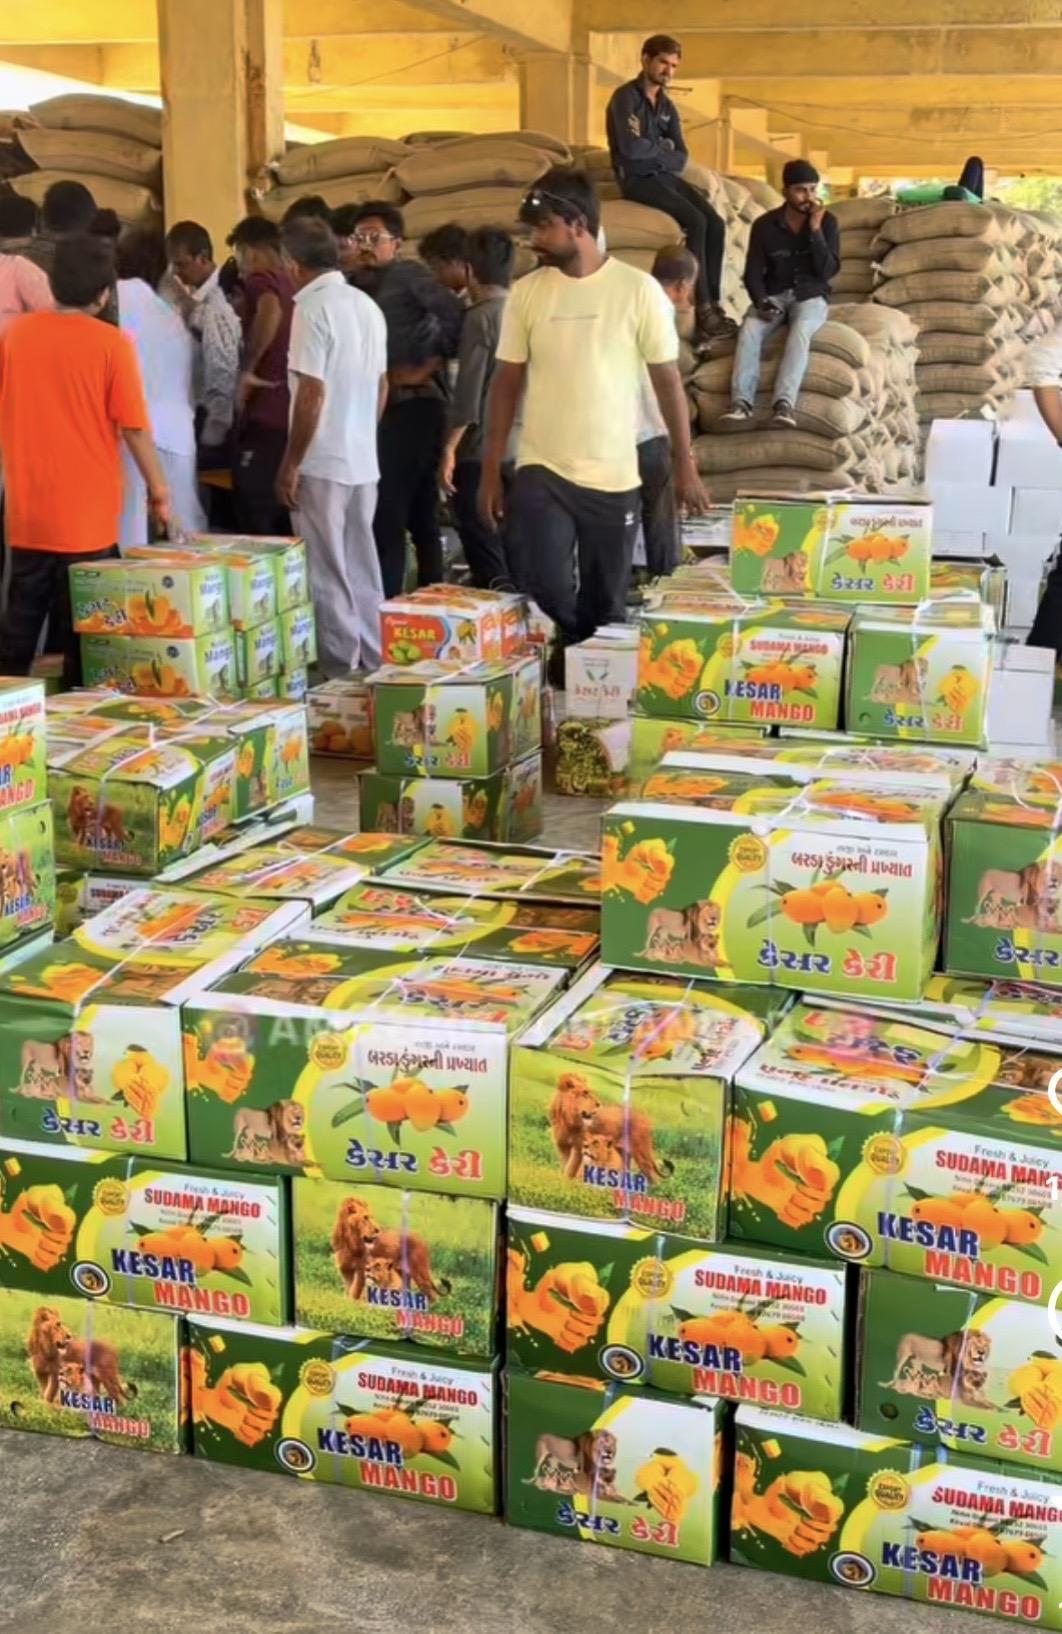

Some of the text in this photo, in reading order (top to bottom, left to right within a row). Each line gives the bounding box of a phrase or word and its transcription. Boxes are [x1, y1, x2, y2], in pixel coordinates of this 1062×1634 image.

[393, 626, 436, 641] KESAR
[724, 679, 781, 700] KESAR
[750, 700, 815, 721] MANGO
[757, 938, 897, 982] કેસર કેરી
[995, 937, 1060, 966] કેસર
[42, 1108, 156, 1144] કેસર કેરી
[345, 1136, 482, 1180] કેસર કેરી
[936, 1150, 1007, 1180] SUDAMA
[974, 1144, 1049, 1168] Fresh & Juicy
[584, 1164, 646, 1193] KESAR
[144, 1187, 261, 1218] SUDAMA MANGO
[614, 1189, 686, 1222] MANGO
[877, 1211, 979, 1257] KESAR
[111, 1248, 194, 1284] KESAR
[734, 1264, 763, 1278] Fresh
[766, 1269, 773, 1279] &
[925, 1249, 1041, 1299] MANGO
[154, 1281, 250, 1318] MANGO
[367, 1287, 427, 1310] KESAR
[694, 1268, 827, 1306] SUDAMA MANGO
[396, 1309, 463, 1337] MANGO
[648, 1333, 741, 1372] KESAR
[60, 1389, 114, 1413] KESAR
[357, 1372, 420, 1398] SUDAMA
[423, 1382, 478, 1407] MANGO
[693, 1367, 801, 1408] MANGO
[91, 1412, 151, 1439] MANGO
[913, 1405, 1051, 1457] કેસર કેરી
[317, 1427, 402, 1466] KESAR
[360, 1461, 457, 1501] MANGO
[977, 1480, 1008, 1496] Fresh
[1010, 1487, 1018, 1497] &
[932, 1486, 1005, 1515] SUDAMA
[556, 1502, 679, 1548] કેસર કેરી
[882, 1541, 983, 1582] KESAR
[928, 1576, 1041, 1620] MANGO
